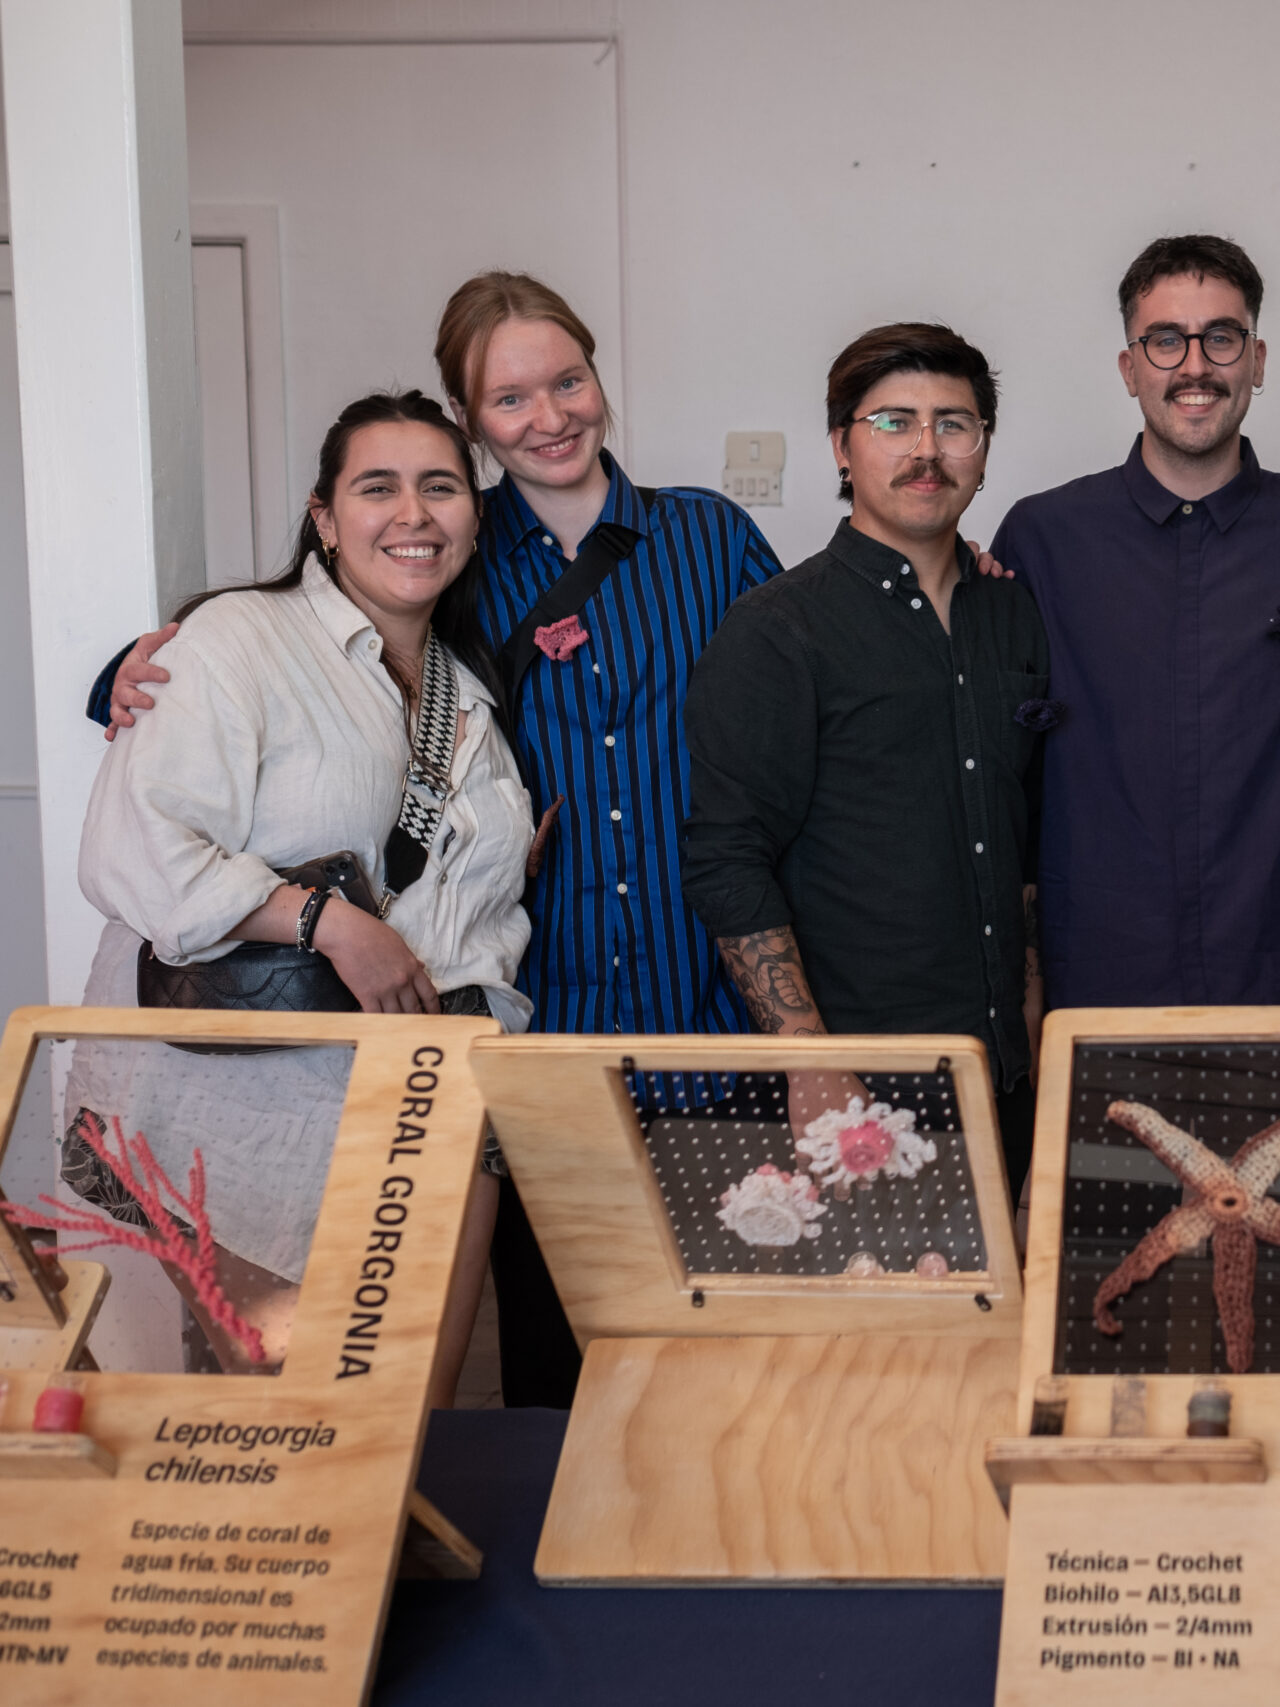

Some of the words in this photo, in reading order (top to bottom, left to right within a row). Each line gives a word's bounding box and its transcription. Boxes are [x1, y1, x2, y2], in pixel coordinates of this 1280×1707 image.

[387, 1045, 445, 1165] CORAL
[334, 1175, 414, 1381] GORGONIA
[153, 1417, 337, 1454] Leptogorgia
[144, 1455, 279, 1485] chilensis
[129, 1519, 211, 1543] Especie
[214, 1522, 242, 1543] de
[245, 1524, 301, 1544] coral
[304, 1525, 332, 1546] de
[121, 1554, 174, 1574] agua
[223, 1553, 252, 1574] Su
[255, 1556, 331, 1578] cuerpo
[1047, 1549, 1129, 1572] Técnica
[1156, 1552, 1243, 1573] Crochet
[110, 1583, 267, 1607] tridimensional
[269, 1591, 294, 1608] es
[1044, 1584, 1120, 1604] Biohilo
[102, 1615, 197, 1638] ocupado
[200, 1620, 239, 1640] por
[242, 1620, 327, 1642] muchas
[1042, 1614, 1148, 1636] Extrusión
[1176, 1616, 1253, 1637] 2/4mm
[95, 1648, 190, 1669] especies
[195, 1649, 223, 1669] de
[226, 1651, 328, 1673] animales.
[1039, 1648, 1146, 1673] Pigmento
[1213, 1650, 1240, 1668] NA
